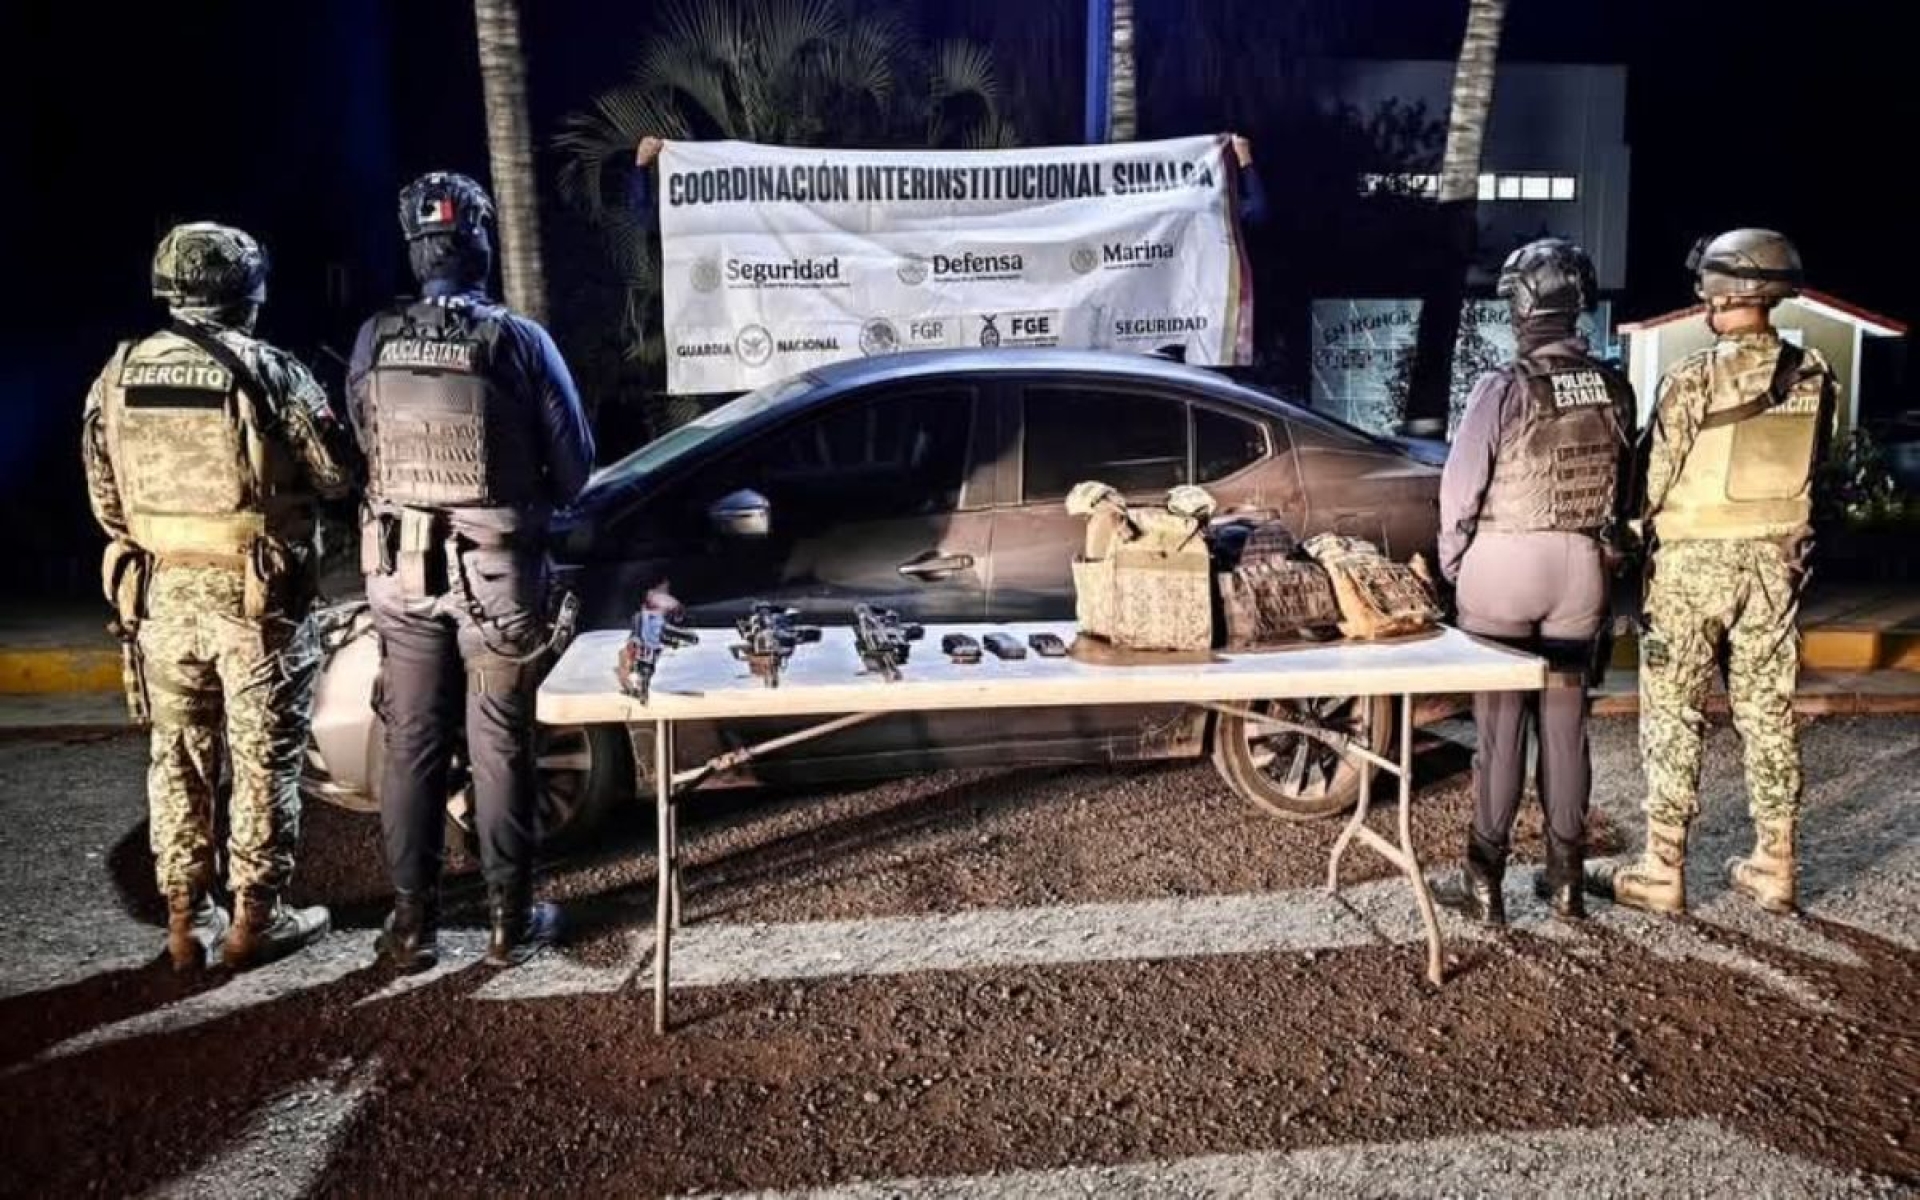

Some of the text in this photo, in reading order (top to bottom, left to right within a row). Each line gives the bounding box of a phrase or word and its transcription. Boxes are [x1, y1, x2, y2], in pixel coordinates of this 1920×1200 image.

[669, 160, 848, 206] COORDINACIÓN
[857, 162, 1106, 201] INTERINSTITUCIONAL
[1103, 240, 1174, 263] Marina
[727, 257, 840, 283] Seguridad
[933, 252, 1023, 274] Defensa
[910, 321, 944, 340] FGR
[1011, 317, 1050, 336] FGE
[1115, 316, 1207, 335] SEGURIDAD
[677, 337, 840, 357] GUARDIA NACIONAL
[1554, 388, 1612, 407] ESTATAL
